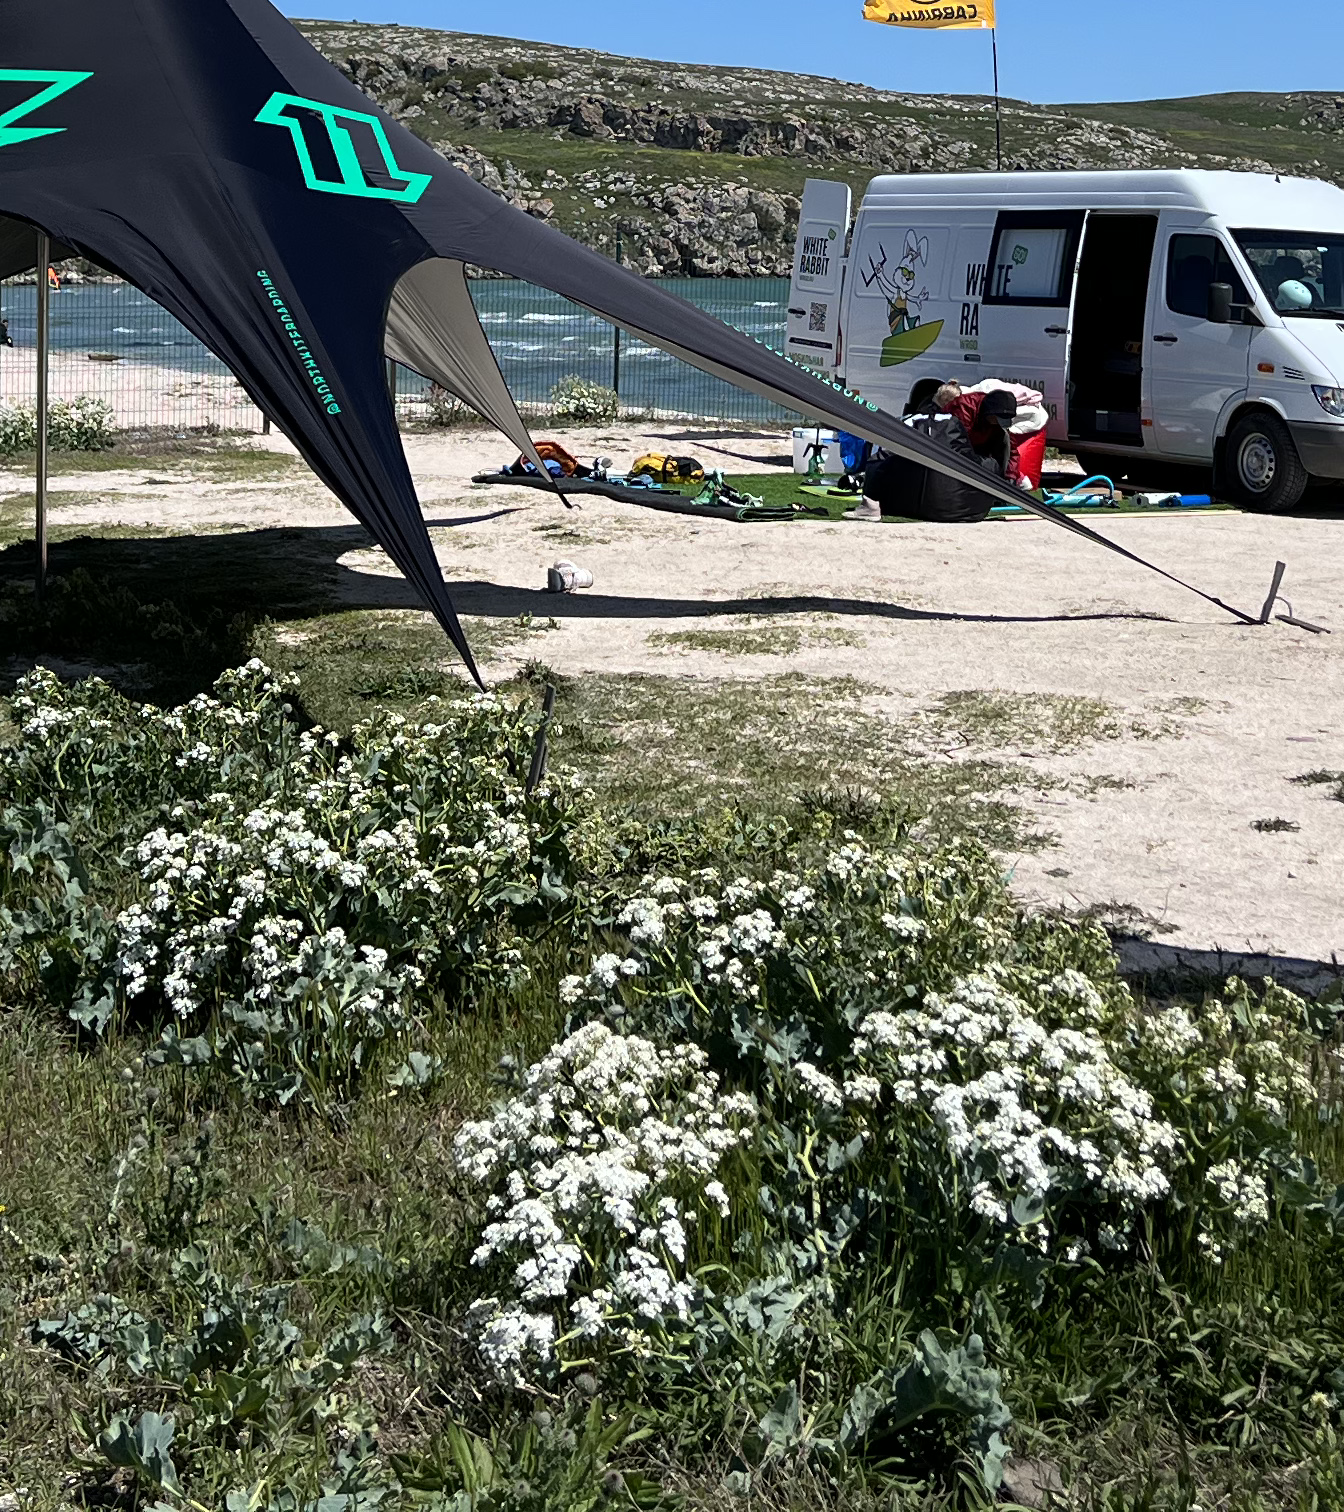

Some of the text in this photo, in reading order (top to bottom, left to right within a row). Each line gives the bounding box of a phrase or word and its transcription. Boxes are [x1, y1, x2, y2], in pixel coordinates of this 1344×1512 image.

[803, 236, 829, 256] WHITE
[799, 254, 830, 276] RABBIT
[965, 263, 1013, 296] WHTE
